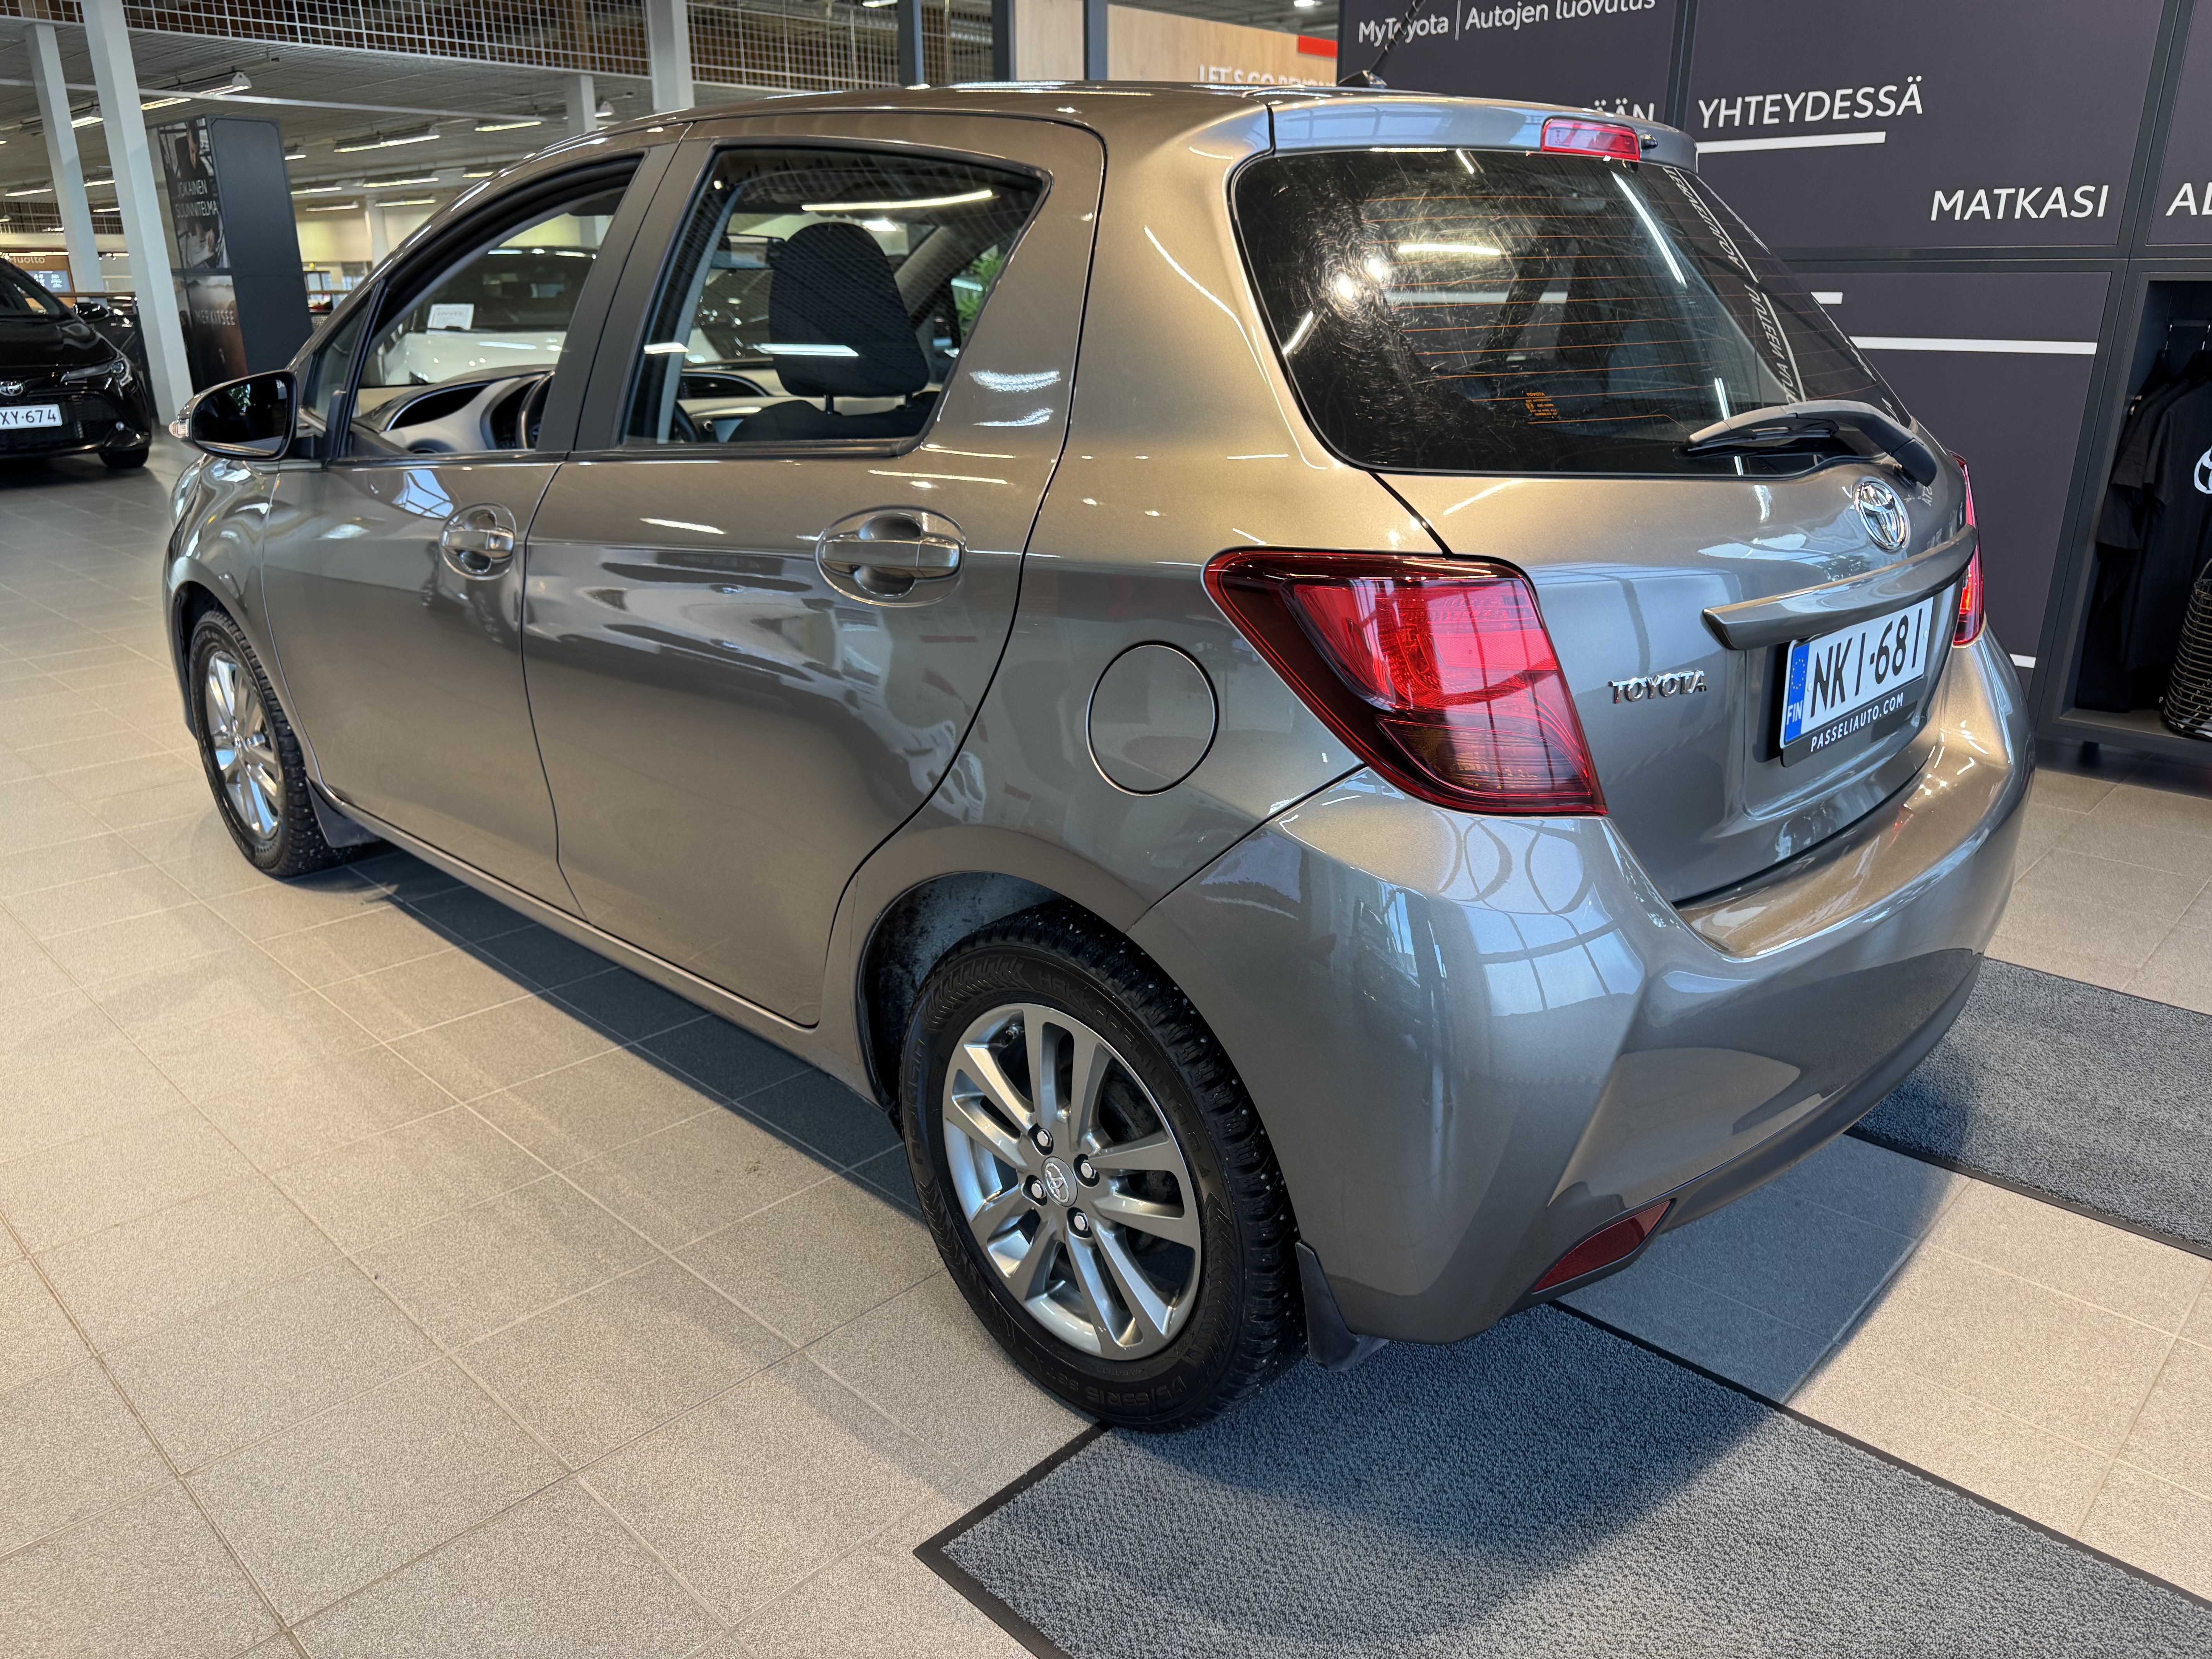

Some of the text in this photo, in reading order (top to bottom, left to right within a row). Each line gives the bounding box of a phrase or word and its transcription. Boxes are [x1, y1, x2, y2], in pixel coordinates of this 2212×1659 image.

[1465, 1, 1548, 31] Autojen
[1698, 76, 1923, 129] YHTEYDESSÄ
[1931, 184, 2109, 222] MATKASI
[1811, 608, 1922, 718] NKI-681
[1608, 669, 1707, 704] TOYOTA
[1786, 700, 1803, 725] FIN
[1810, 692, 1904, 753] PASSELIAUTO.COM
